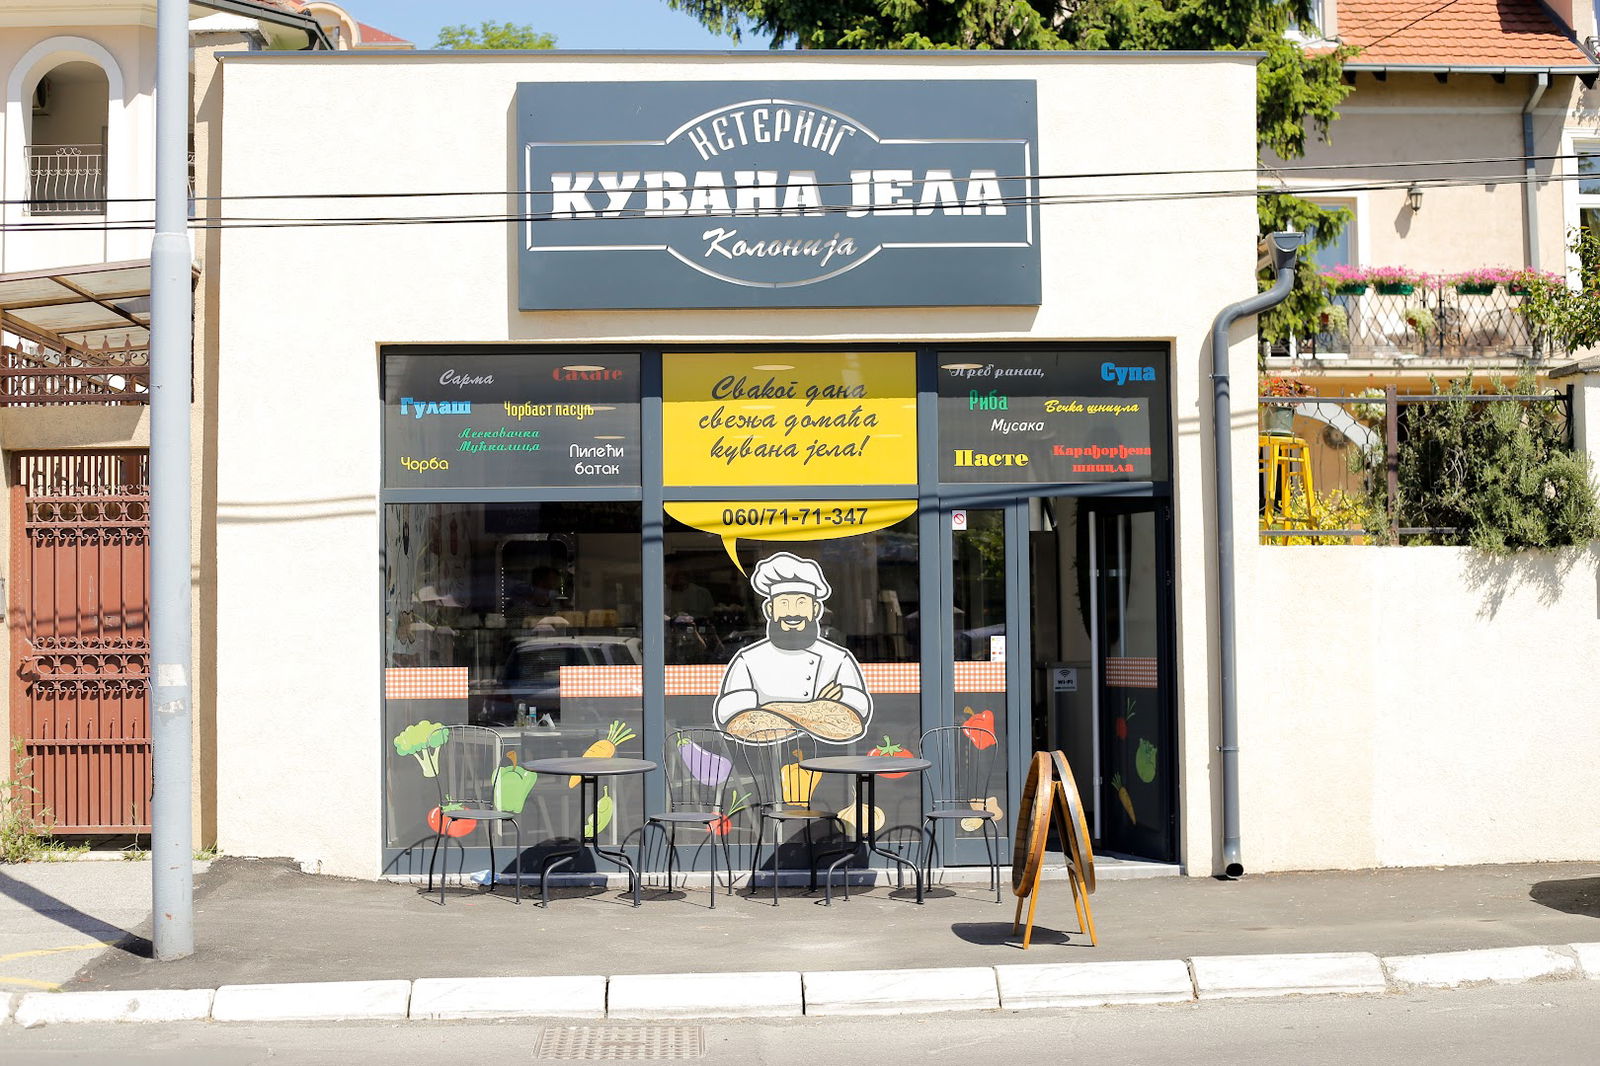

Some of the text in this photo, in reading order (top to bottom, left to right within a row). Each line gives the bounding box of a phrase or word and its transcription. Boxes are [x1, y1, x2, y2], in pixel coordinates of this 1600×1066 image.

[688, 108, 856, 161] КЕТЕРИНГ
[551, 169, 1008, 219] КУВАНА ЈЕЛА
[702, 228, 858, 267] Колонија
[439, 369, 494, 389] Сарма
[1100, 362, 1156, 385] Супа
[805, 384, 868, 407] дана
[969, 389, 1008, 411] Риба
[400, 397, 471, 419] Гулаш
[504, 401, 595, 421] Чорбаст пасуљ
[784, 405, 879, 436] домаћа
[991, 418, 1045, 435] Мусака
[458, 426, 541, 439] Лесковачка
[569, 443, 624, 459] Пилећи
[710, 435, 871, 466] кувана јела!
[954, 449, 1029, 467] Пасте
[1051, 444, 1152, 460] Карађорђева
[400, 456, 449, 474] Чорба
[574, 461, 620, 476] батак
[722, 507, 869, 526] 060/71-71-347
